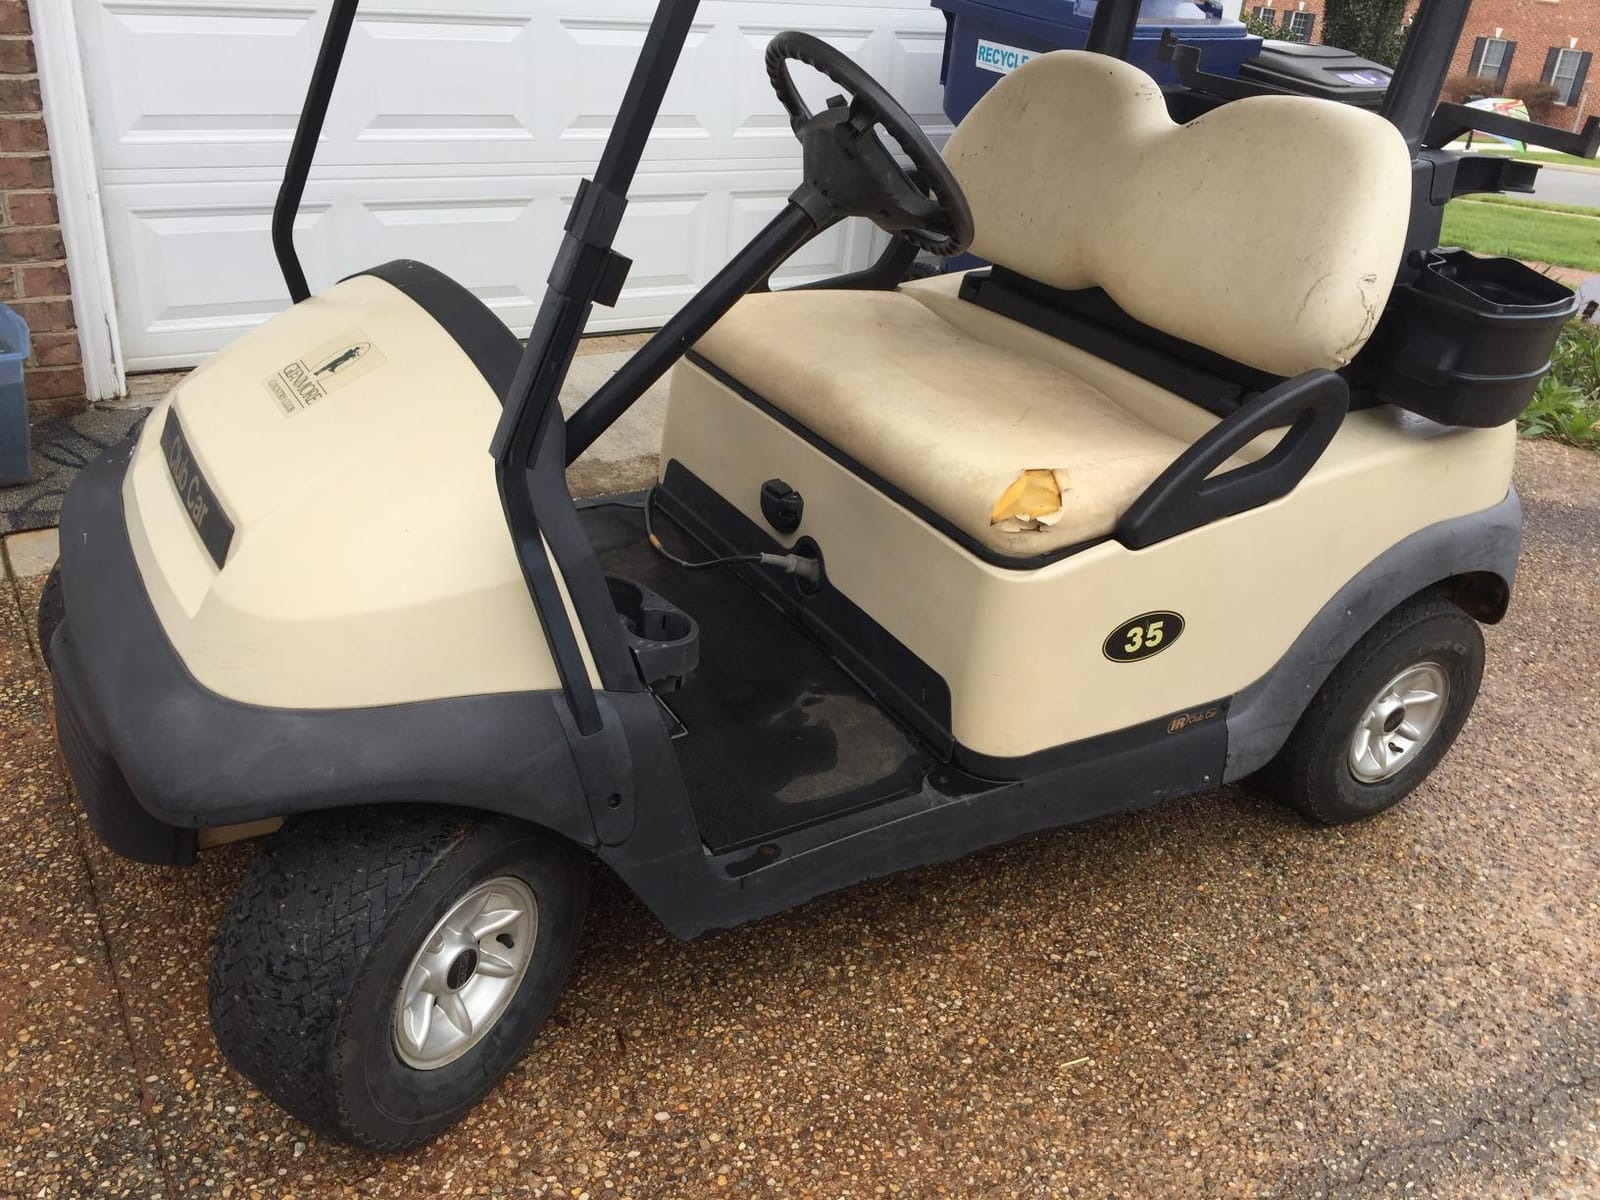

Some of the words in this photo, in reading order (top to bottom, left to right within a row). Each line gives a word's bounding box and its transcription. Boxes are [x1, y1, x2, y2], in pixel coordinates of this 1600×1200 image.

[169, 434, 189, 493] Club
[186, 475, 209, 528] Car
[1124, 621, 1164, 653] 35
